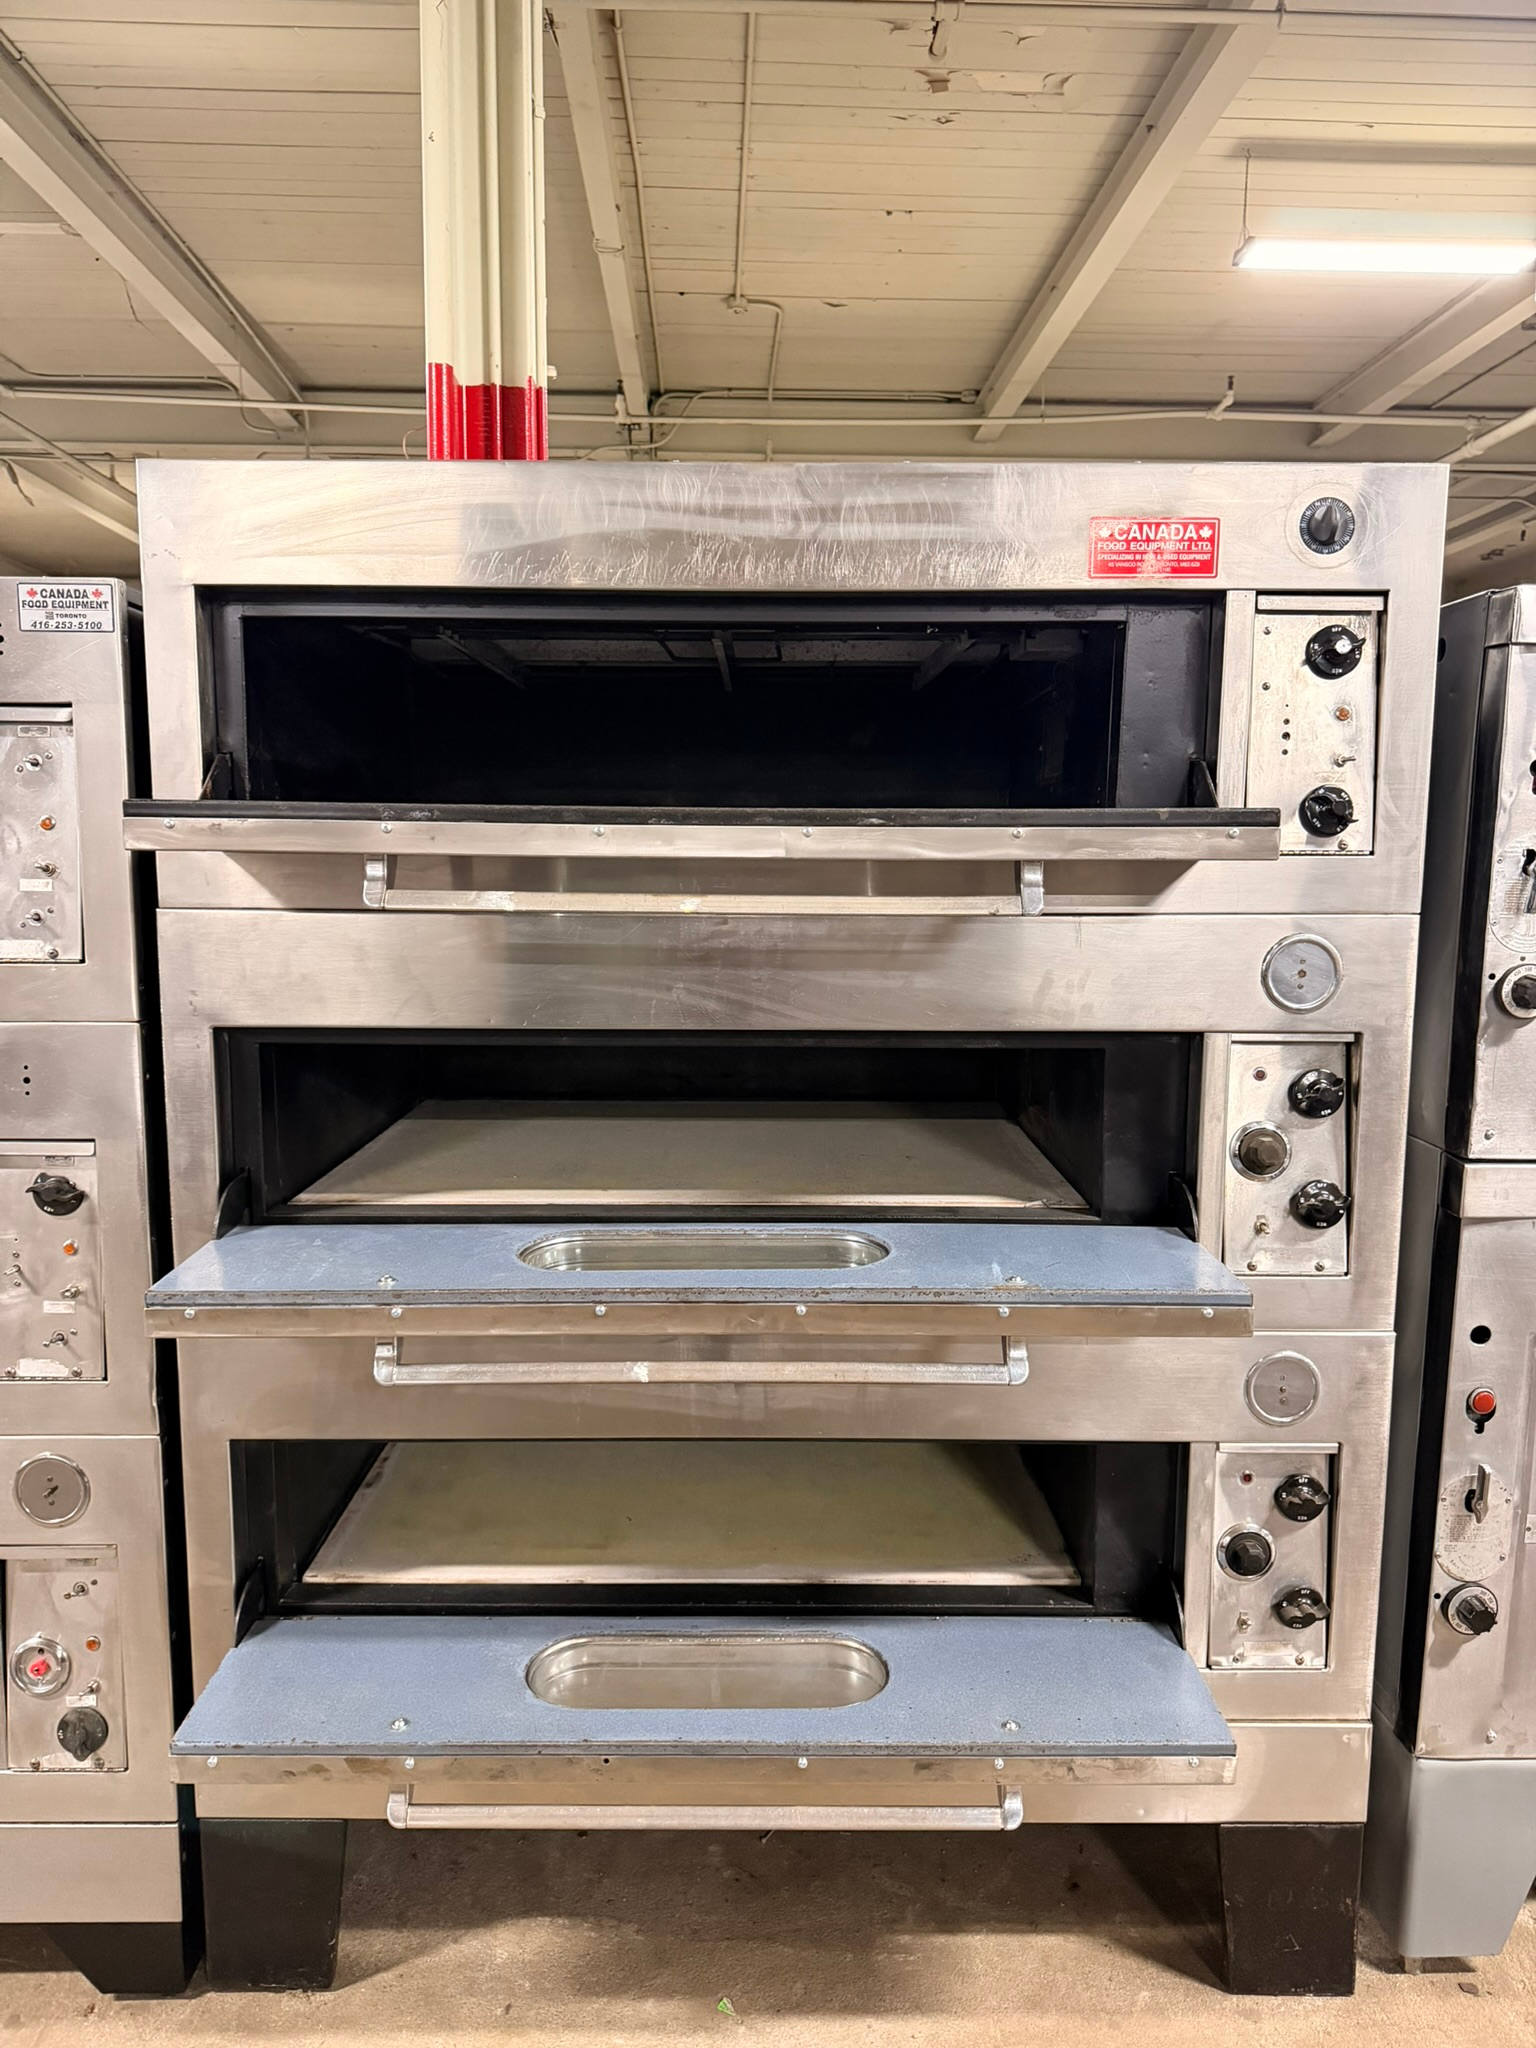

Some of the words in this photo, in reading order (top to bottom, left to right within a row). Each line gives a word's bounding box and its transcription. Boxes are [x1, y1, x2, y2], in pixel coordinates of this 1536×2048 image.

[1114, 523, 1198, 541] CANADA
[1097, 541, 1126, 551] FOOD
[1130, 541, 1190, 552] EQUIPMENT
[1191, 541, 1212, 551] LTD.
[40, 588, 89, 599] CANADA
[22, 600, 48, 609] FOOD
[51, 600, 109, 610] EQUIPMENT
[31, 621, 103, 630] 416-253-5100
